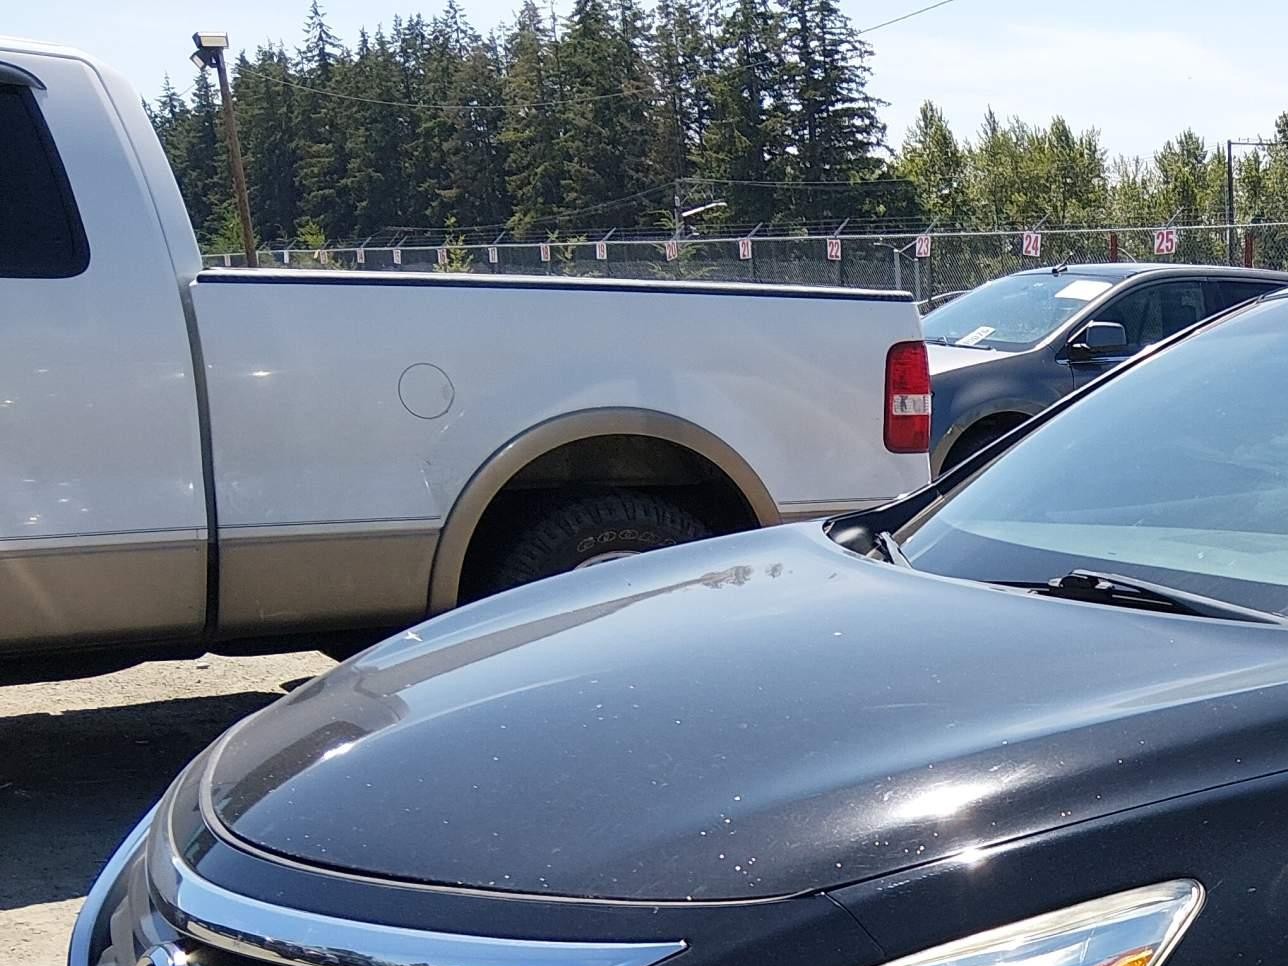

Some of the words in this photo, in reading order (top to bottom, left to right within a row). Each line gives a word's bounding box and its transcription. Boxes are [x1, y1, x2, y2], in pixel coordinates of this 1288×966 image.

[667, 242, 676, 259] 20
[741, 241, 750, 257] 21
[828, 241, 840, 258] 22
[917, 237, 929, 255] 23
[1025, 234, 1039, 255] 24
[1156, 231, 1174, 253] 25
